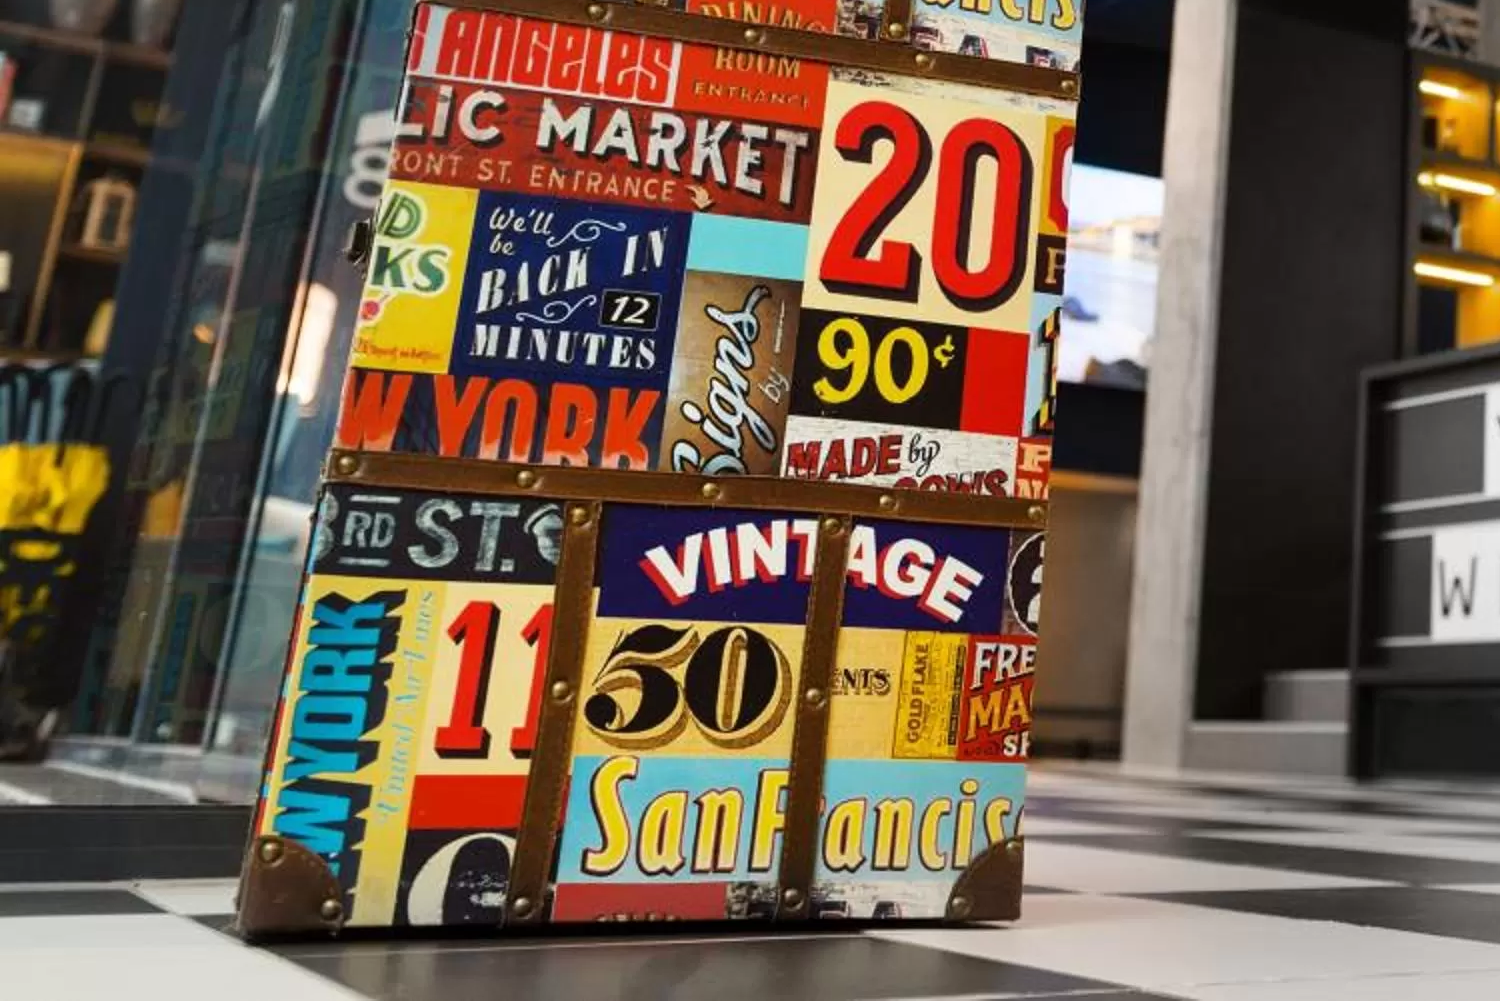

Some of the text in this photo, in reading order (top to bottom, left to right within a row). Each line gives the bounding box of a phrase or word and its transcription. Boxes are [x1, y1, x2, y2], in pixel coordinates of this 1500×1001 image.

[390, 150, 677, 201] RONT ST. ENTRANCE
[537, 97, 810, 209] MARKET
[488, 205, 555, 236] We'll
[820, 101, 1030, 311] 20
[475, 226, 669, 315] BACK IN
[489, 233, 515, 256] be
[468, 323, 657, 370] MINUTES
[609, 295, 650, 324] 12
[434, 375, 660, 471] YORK
[787, 433, 941, 481] MADE by
[408, 498, 518, 573] ST.
[640, 520, 983, 621] VINTAGE
[584, 625, 792, 749] 50
[832, 668, 891, 696] ENTS
[907, 642, 929, 744] GOLD FLAKE
[965, 682, 1033, 741] MA
